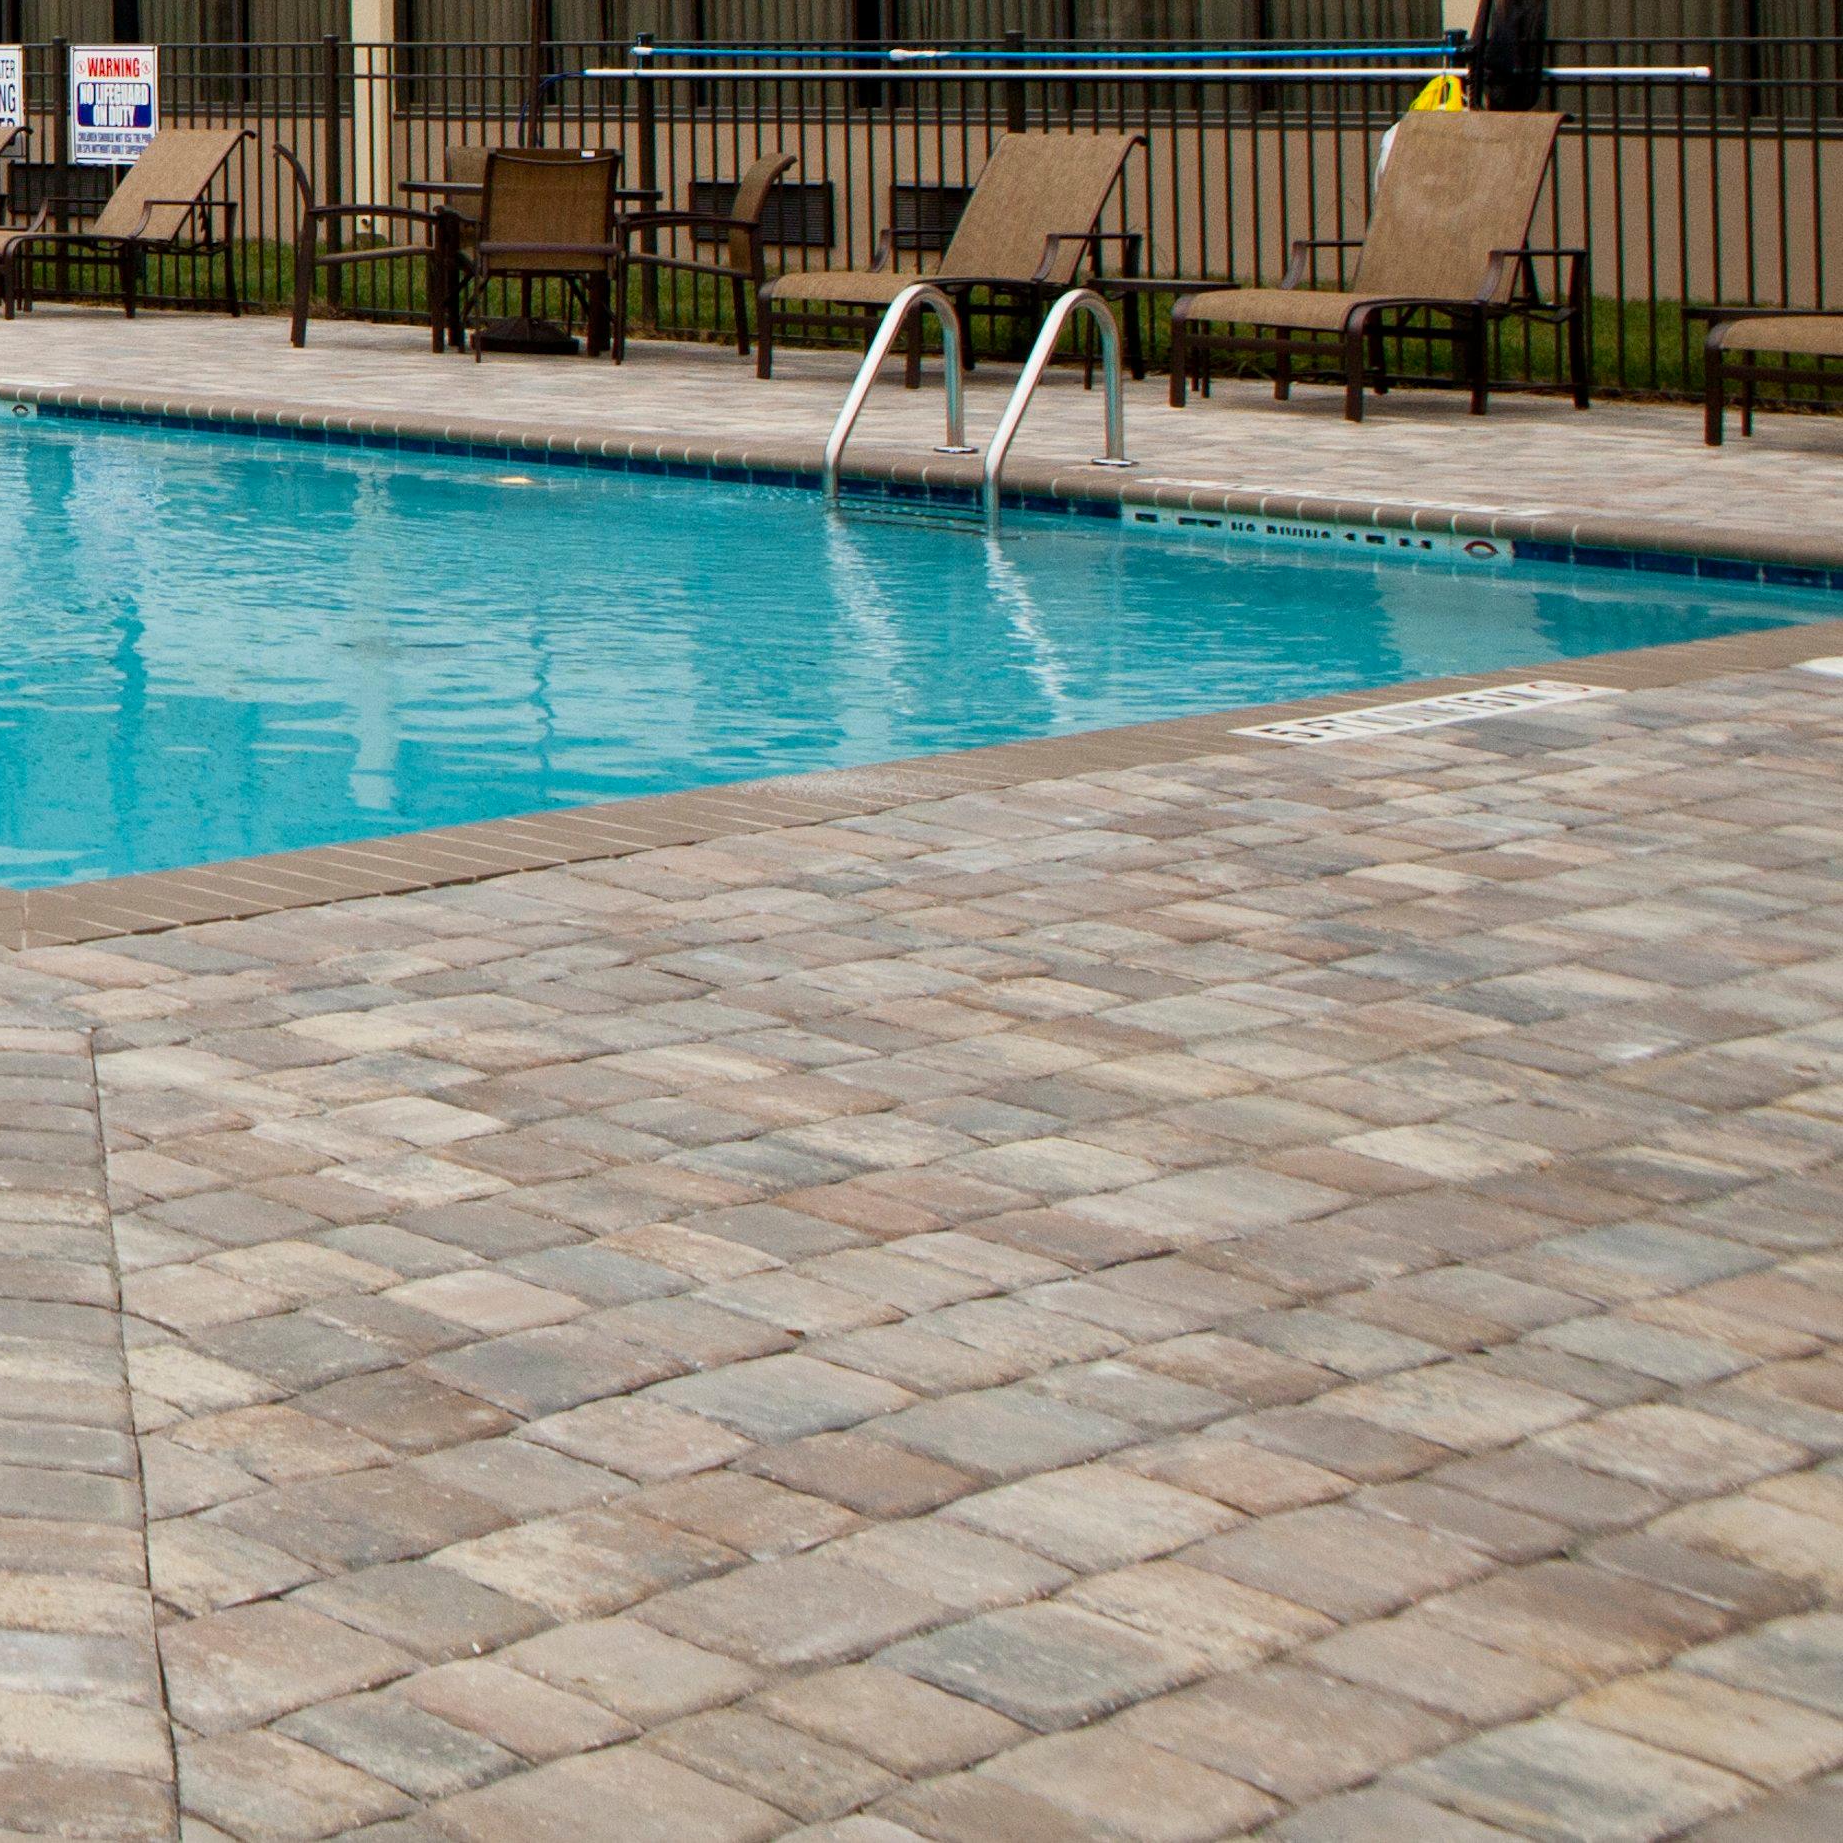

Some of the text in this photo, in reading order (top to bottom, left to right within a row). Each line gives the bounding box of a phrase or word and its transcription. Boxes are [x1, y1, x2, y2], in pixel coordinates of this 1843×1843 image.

[87, 57, 140, 77] WARNING
[79, 83, 150, 105] NO LIFEGUARD
[93, 105, 135, 127] ON DUTY
